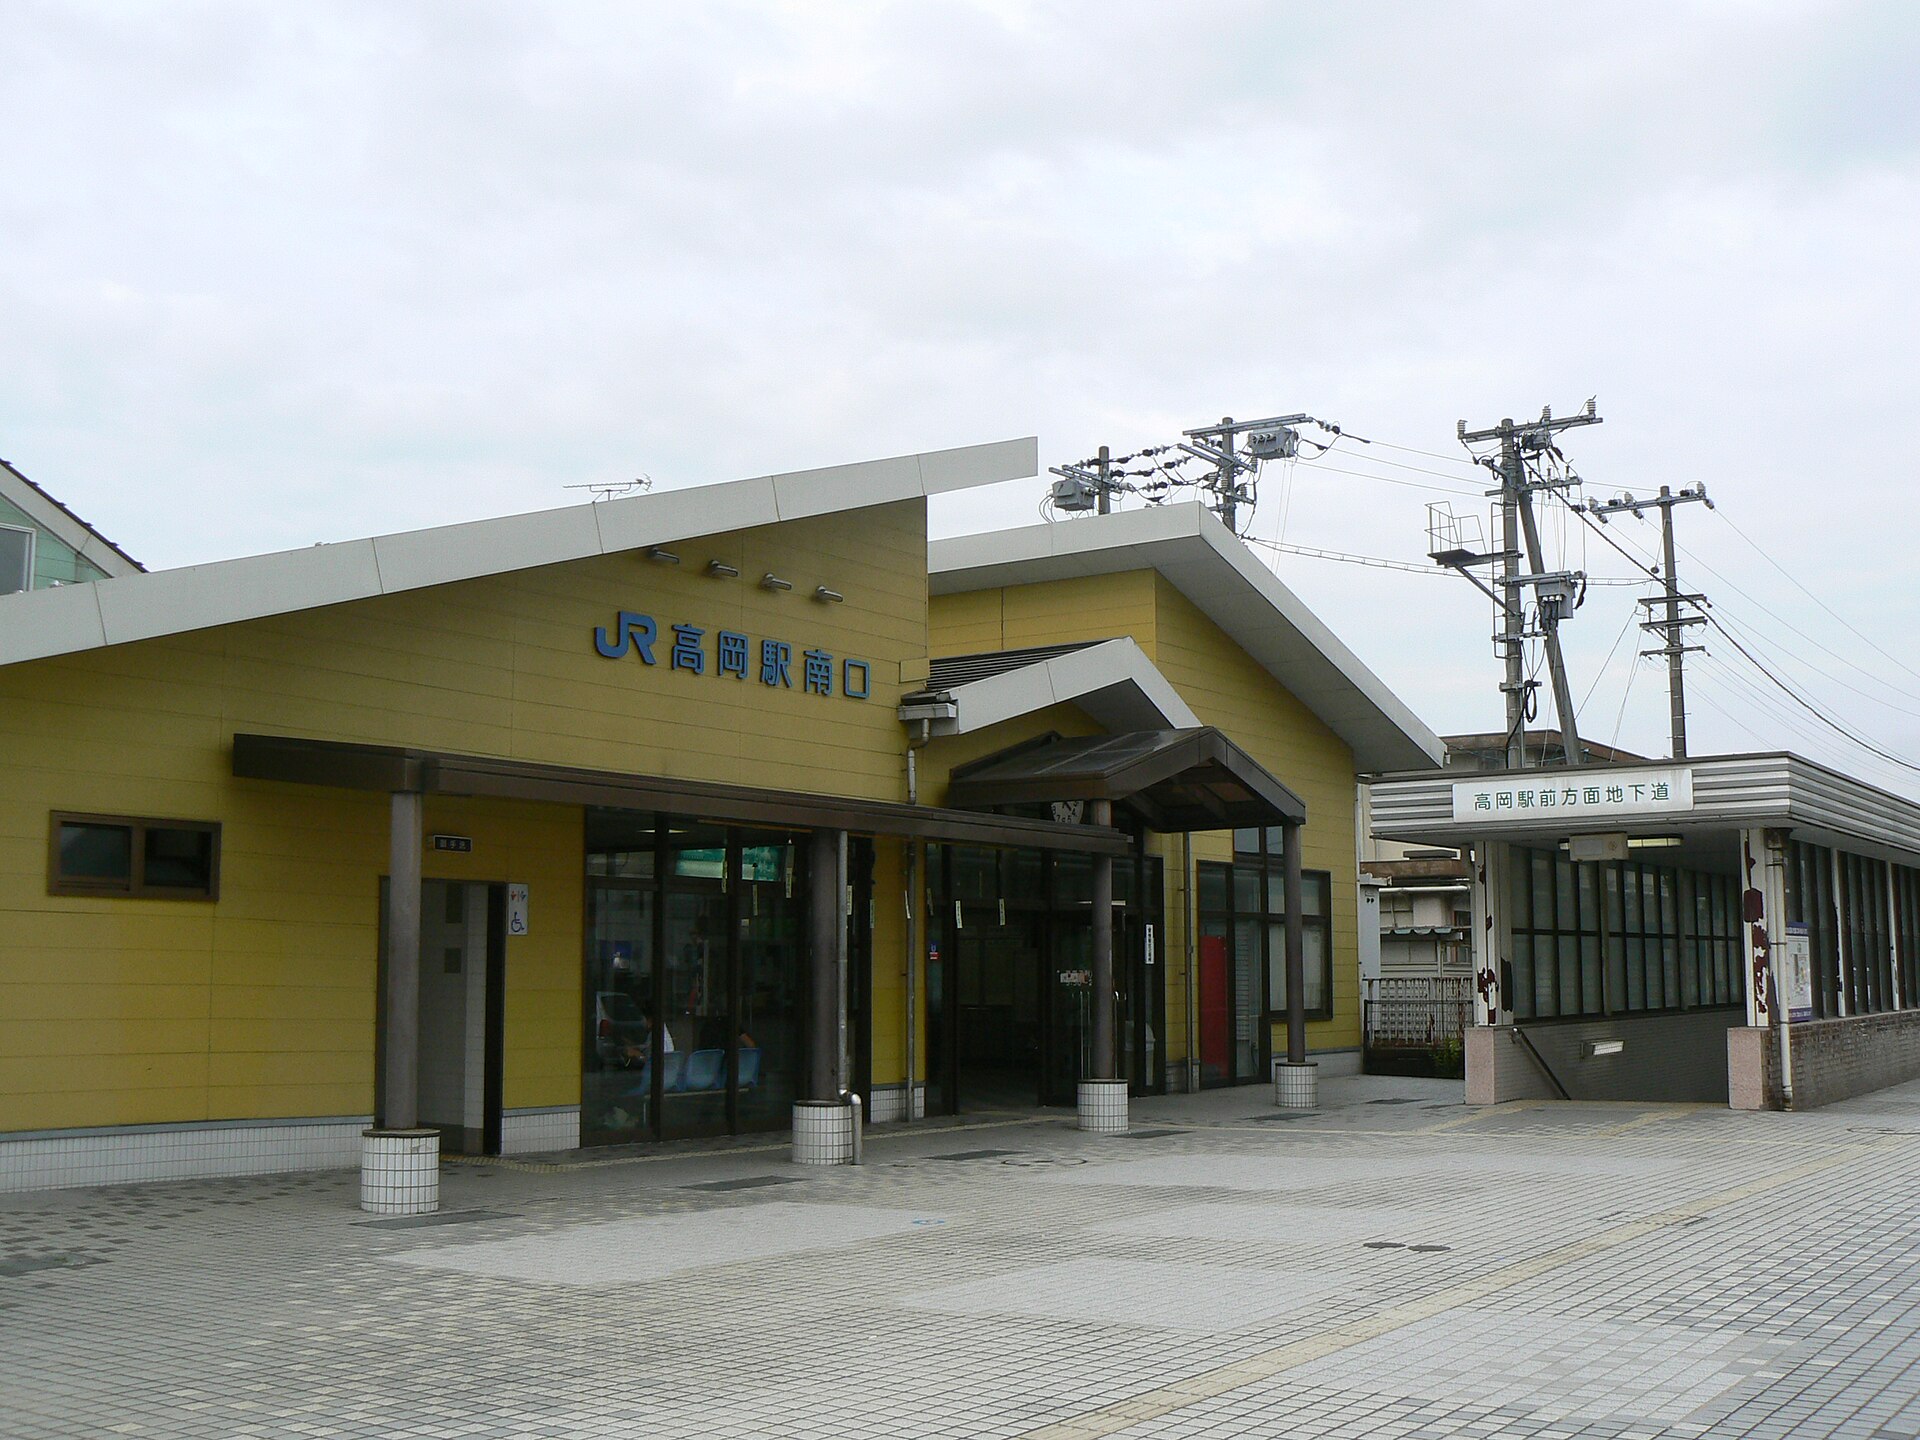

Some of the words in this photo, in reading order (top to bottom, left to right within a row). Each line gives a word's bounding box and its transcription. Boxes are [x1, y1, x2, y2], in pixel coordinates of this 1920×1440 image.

[594, 610, 656, 665] JR
[671, 623, 871, 699] 高岡駅南口
[1473, 782, 1670, 811] 高岡駅前方面地下道
